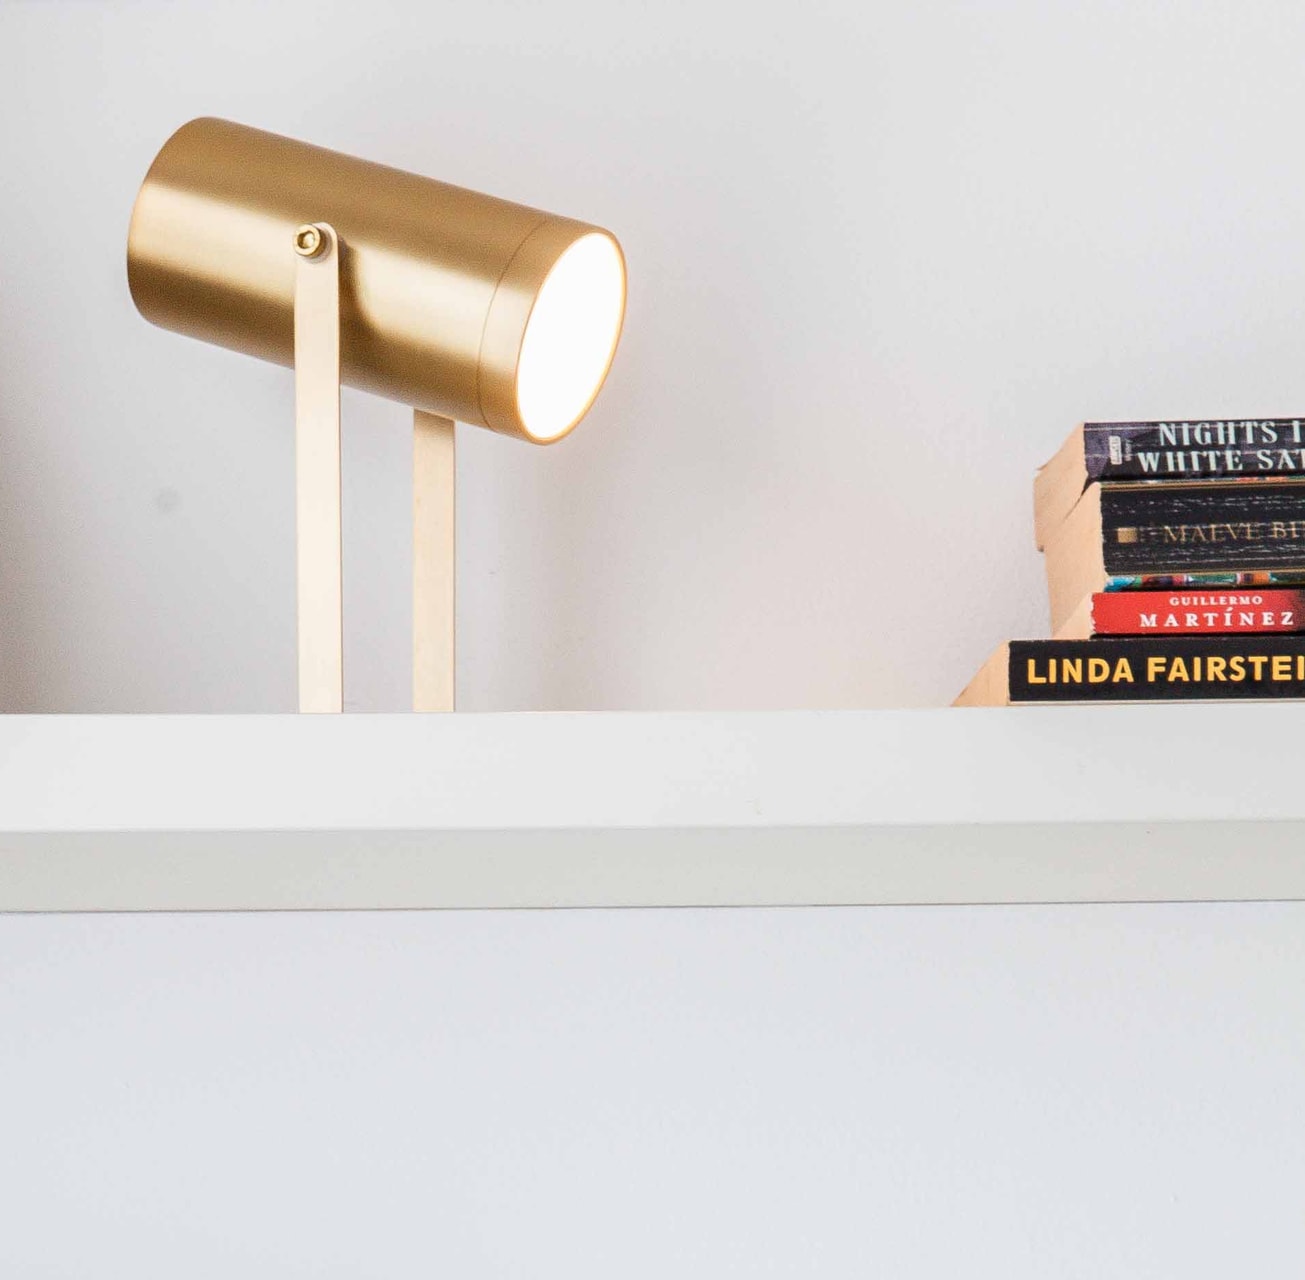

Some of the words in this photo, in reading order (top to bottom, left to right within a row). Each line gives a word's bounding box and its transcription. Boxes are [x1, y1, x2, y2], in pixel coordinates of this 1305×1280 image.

[1158, 421, 1279, 446] NIGHTS
[1138, 452, 1244, 473] WHITE
[1163, 523, 1262, 544] MAEVE
[1169, 595, 1263, 606] GUILLERMO
[1139, 607, 1294, 628] MARTÍNEZ
[1026, 657, 1135, 684] LINDA
